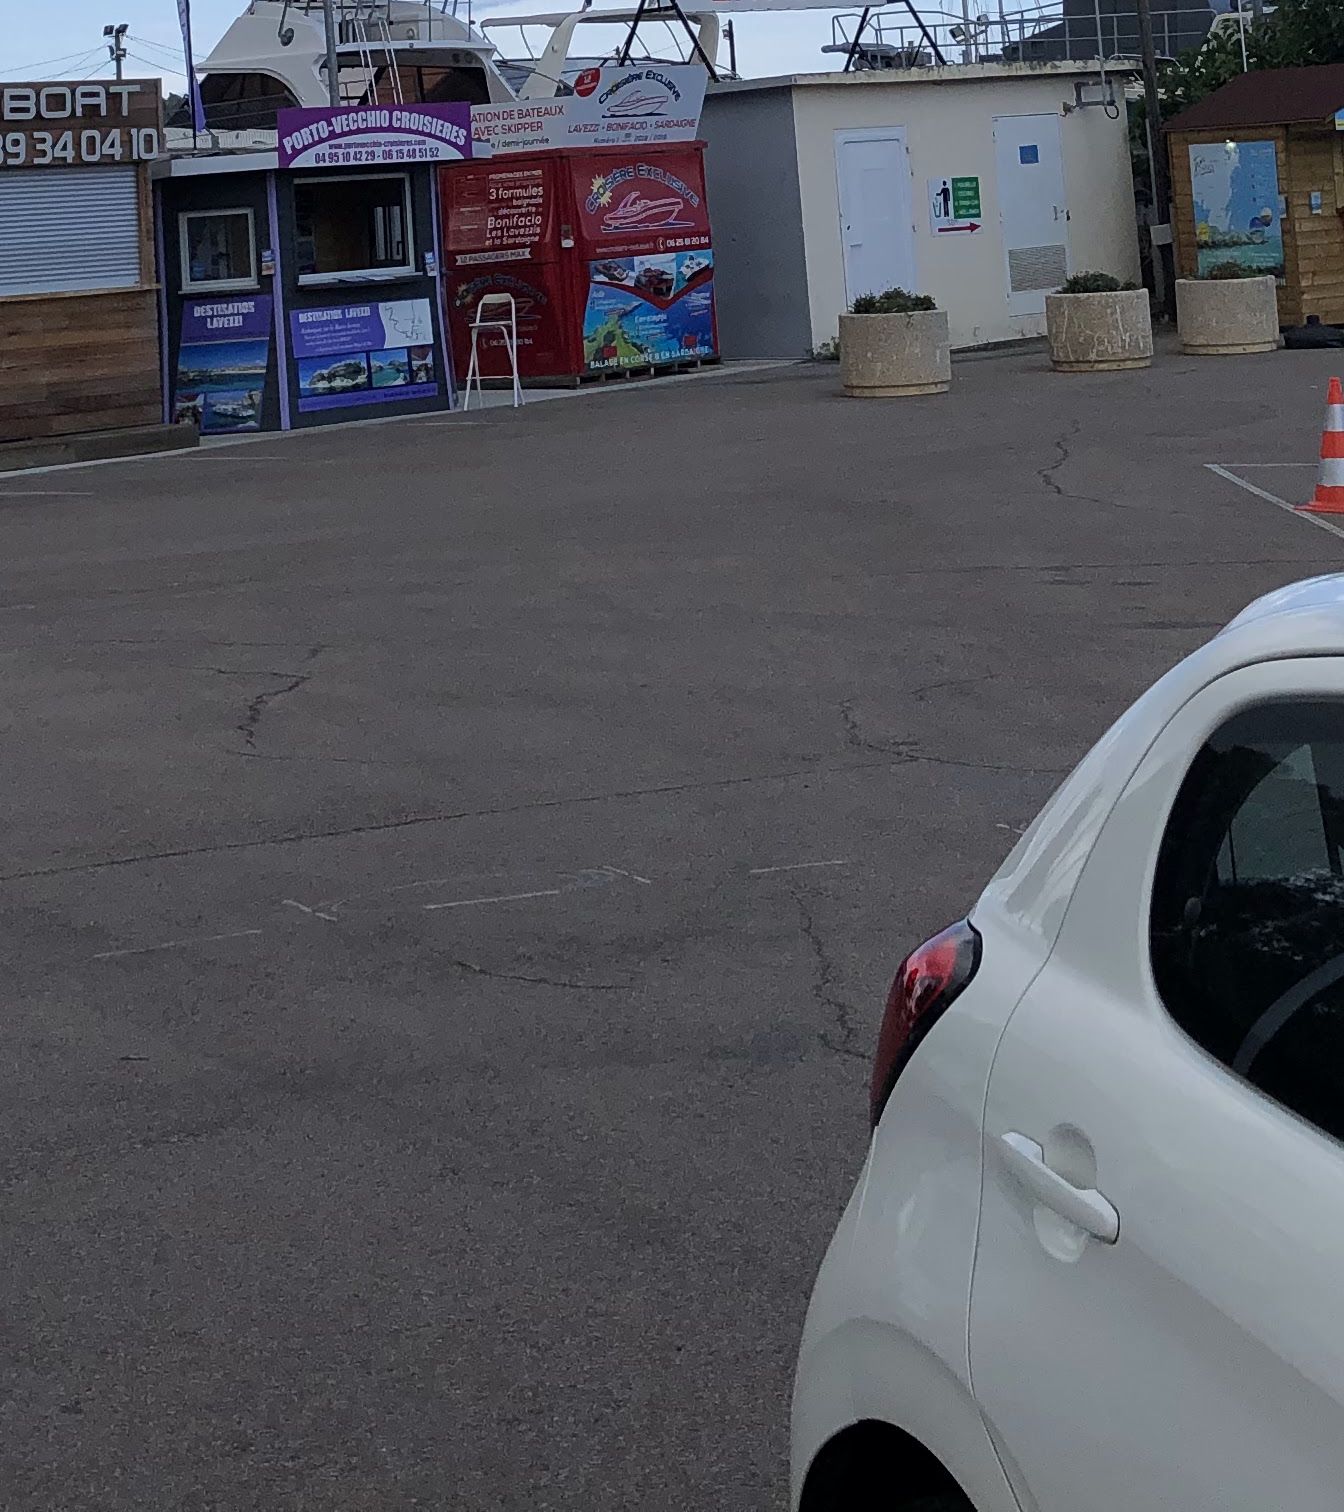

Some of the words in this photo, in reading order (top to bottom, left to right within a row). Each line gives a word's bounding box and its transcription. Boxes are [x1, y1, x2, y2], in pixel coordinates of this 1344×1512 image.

[3, 85, 141, 121] BOAT
[471, 110, 501, 124] ATION
[502, 109, 516, 121] DE
[517, 104, 565, 120] BATEAUX
[282, 109, 391, 155] PORTO-VECCHIO
[392, 110, 467, 146] CROISIERES
[473, 124, 500, 138] AVEC
[501, 120, 544, 135] SKIPPER
[606, 121, 647, 132] BONIFACIO
[654, 118, 696, 129] SARDAIGNE
[33, 130, 75, 165] 34
[80, 128, 123, 162] 04
[131, 127, 158, 160] 10
[314, 152, 327, 164] 04
[327, 151, 340, 164] 95
[341, 150, 351, 163] 10
[352, 150, 363, 162] 42
[364, 149, 376, 162] 29
[381, 149, 394, 160] 06
[395, 148, 405, 160] 15
[418, 147, 428, 159] 51
[428, 146, 440, 158] 52
[489, 188, 497, 200] 3
[498, 185, 544, 199] formules
[487, 214, 542, 229] Bonifacio
[486, 228, 502, 238] Les
[502, 235, 540, 245] Sardaigne
[510, 250, 527, 259] MAX
[193, 301, 255, 317] DESTINATION
